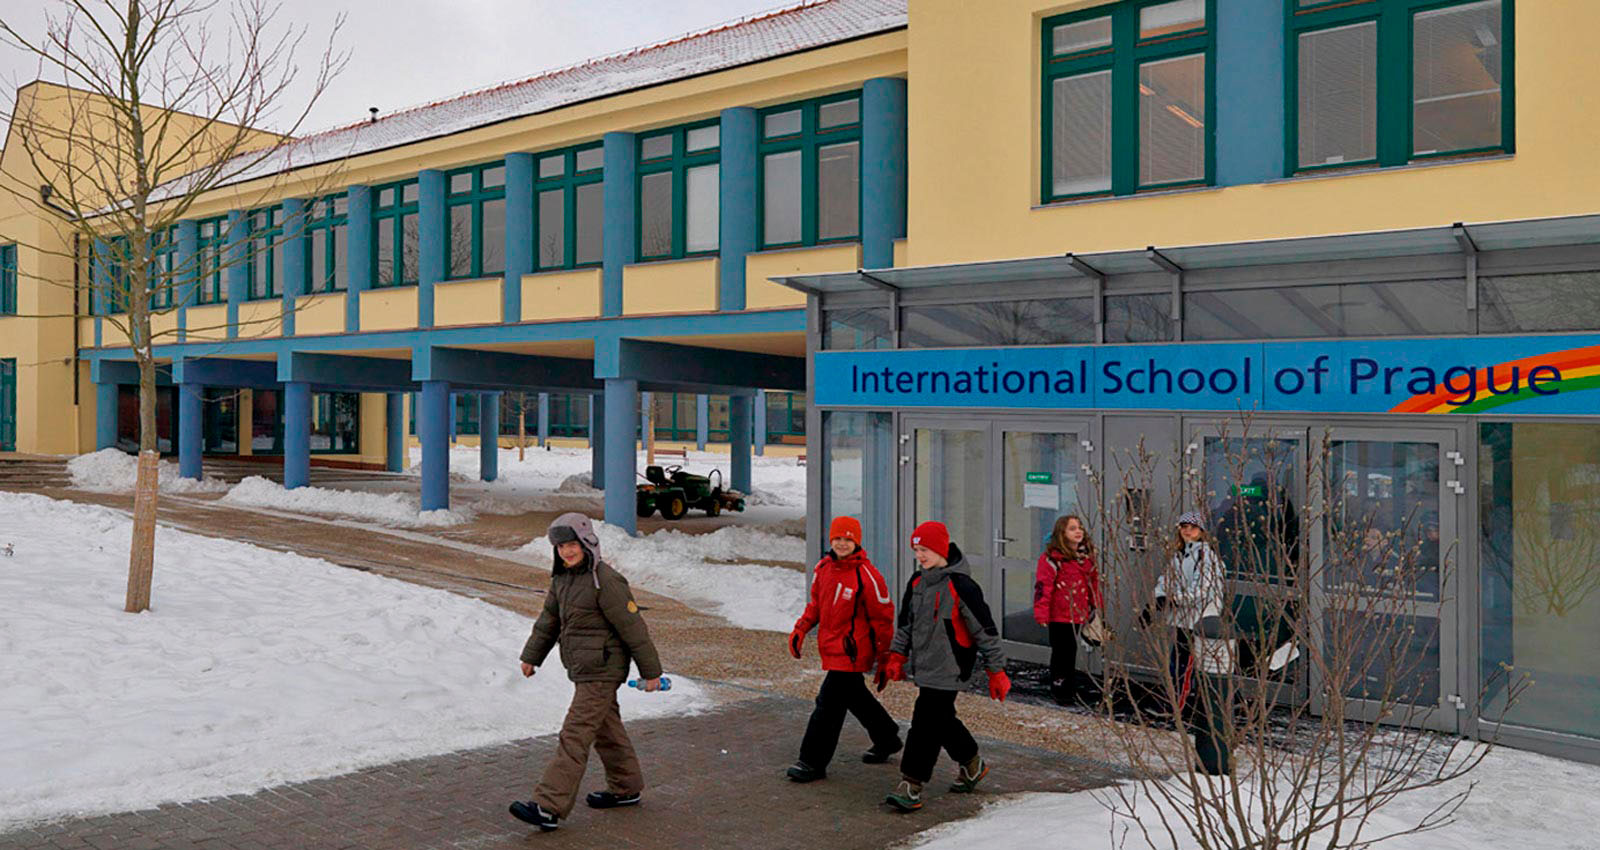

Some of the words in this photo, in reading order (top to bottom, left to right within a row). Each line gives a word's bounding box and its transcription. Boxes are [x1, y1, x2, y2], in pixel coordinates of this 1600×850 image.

[852, 360, 1086, 394] International
[1103, 356, 1250, 394] School
[1274, 355, 1329, 394] of
[1350, 358, 1562, 406] Prague
